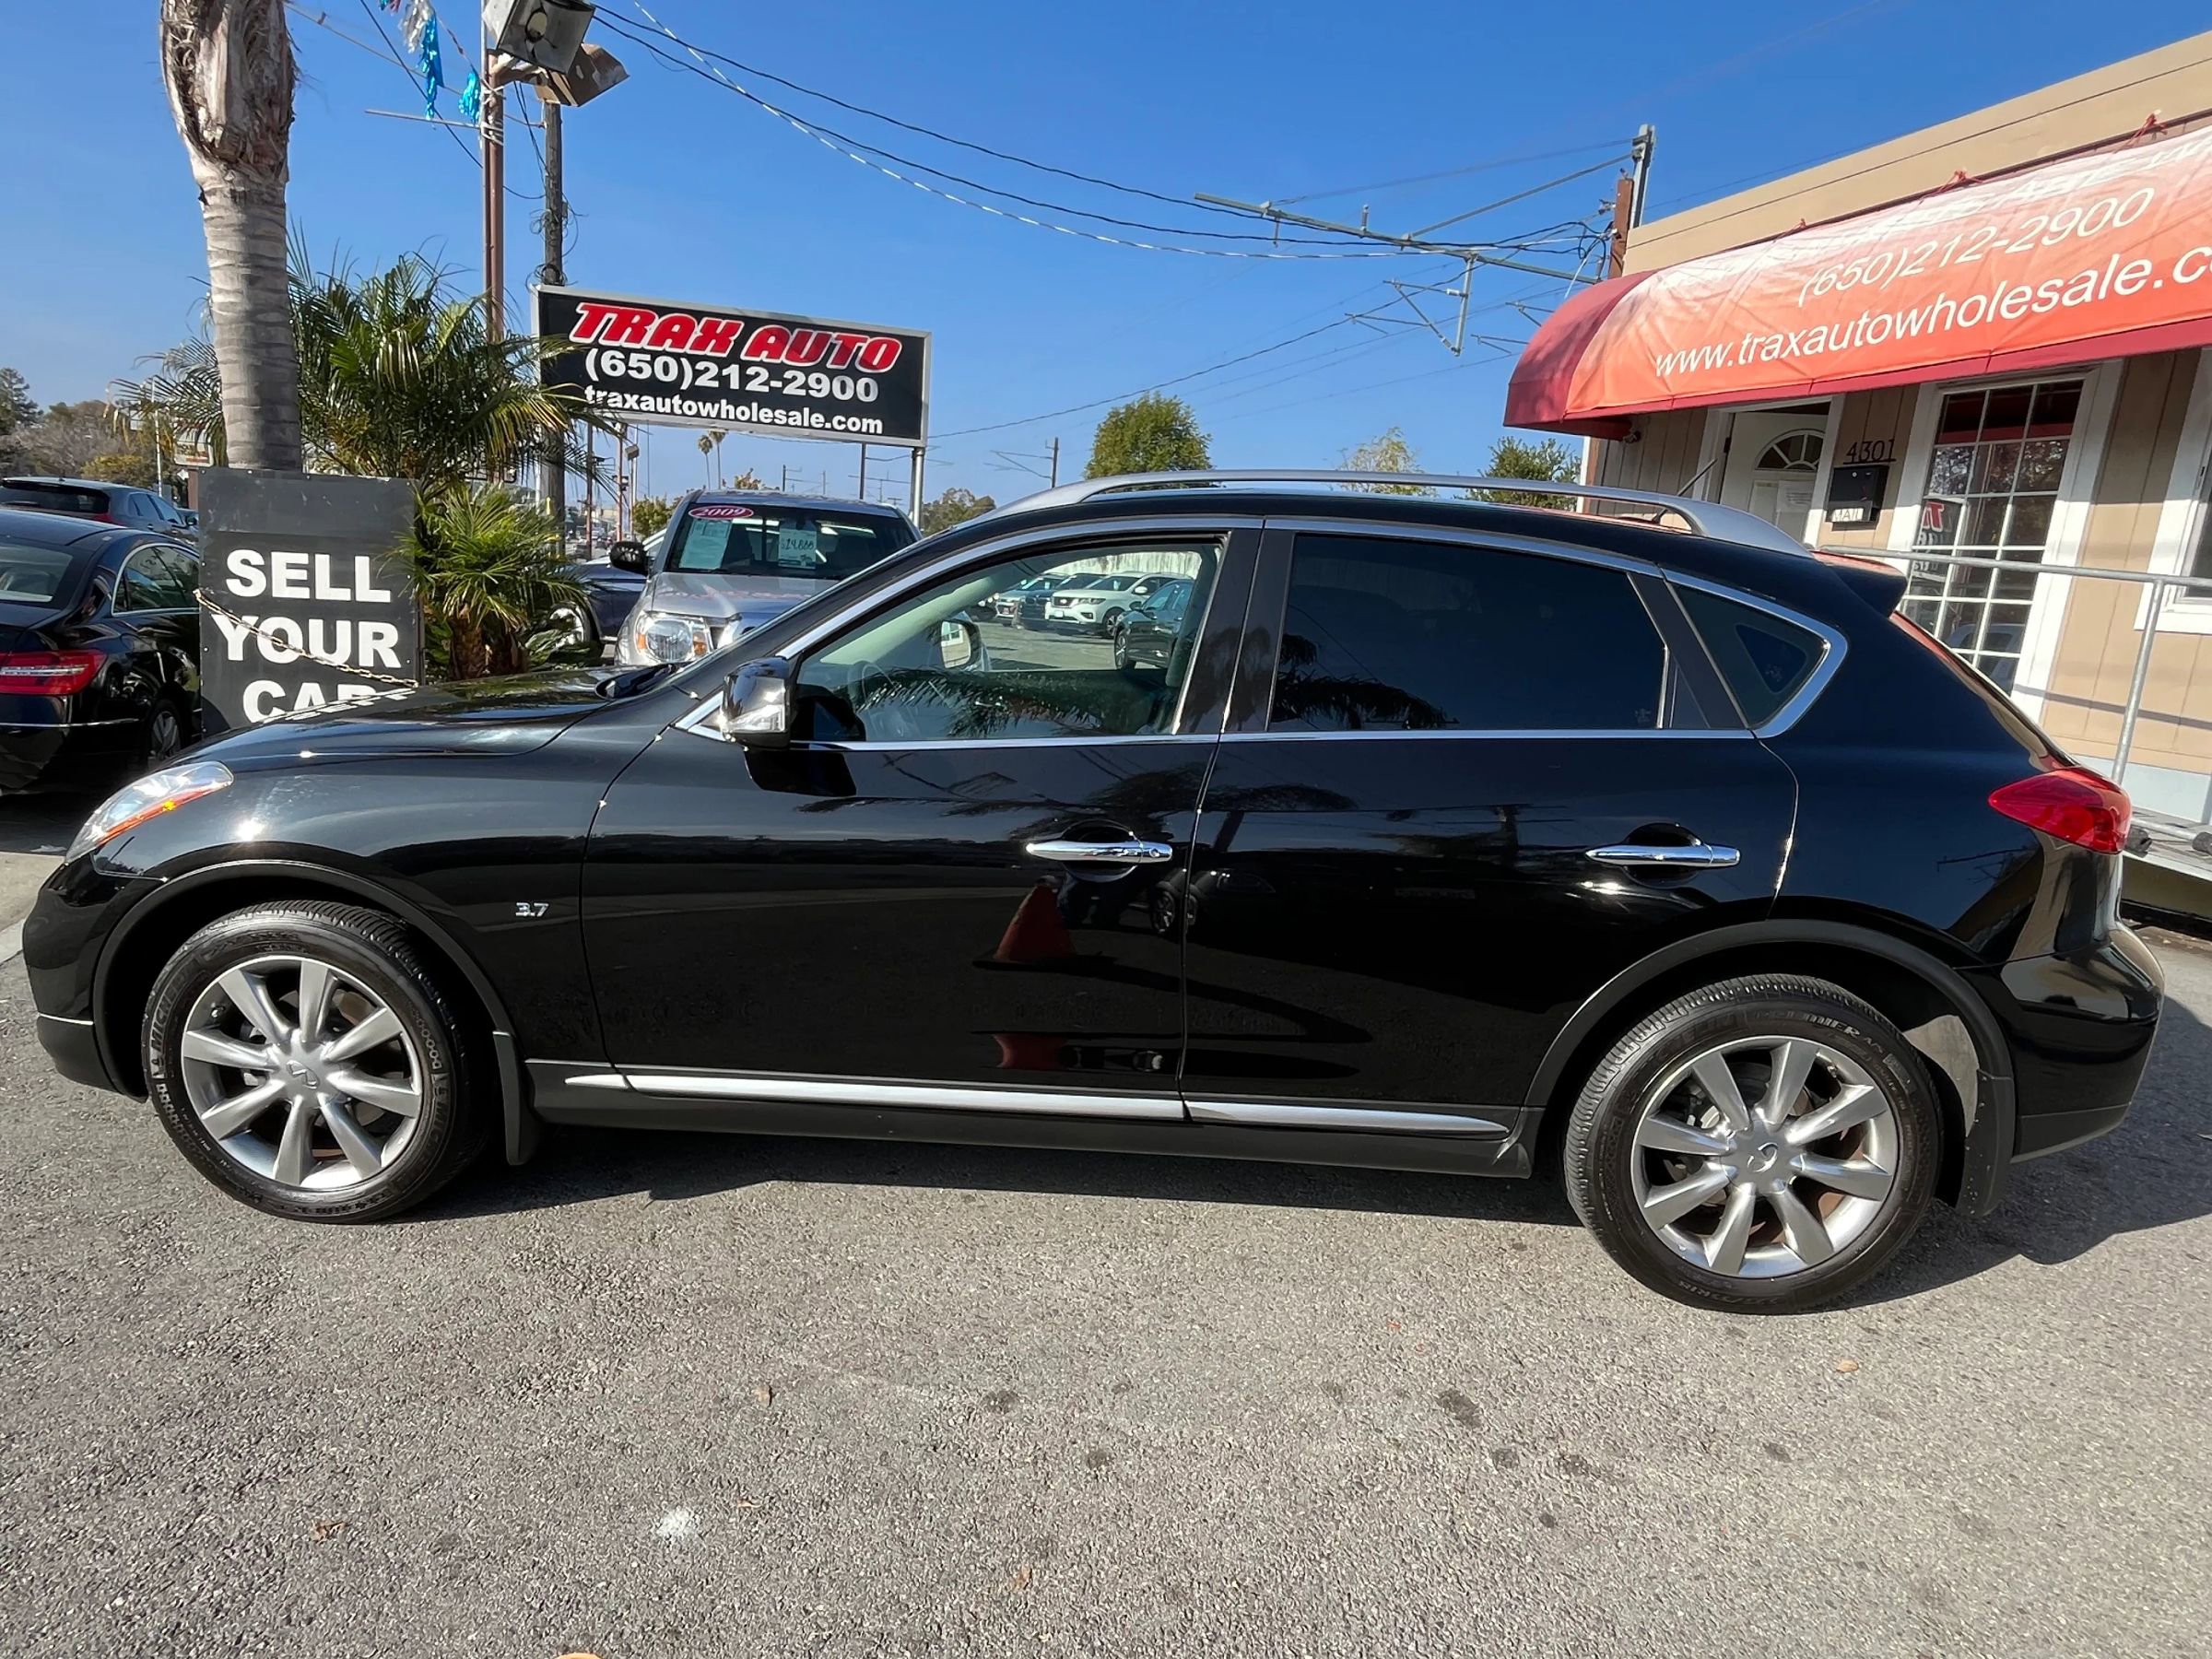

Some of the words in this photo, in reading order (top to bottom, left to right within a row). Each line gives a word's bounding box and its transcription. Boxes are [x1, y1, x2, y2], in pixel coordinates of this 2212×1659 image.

[1799, 187, 2155, 306] (650)212-2900
[570, 302, 744, 356] TRAX
[741, 324, 902, 372] AUTO
[1656, 246, 2212, 377] www.traxautowholesale.c
[585, 348, 879, 402] (650)212-2900
[583, 384, 882, 434] traxautowholesale.com
[1846, 439, 1894, 463] 4301
[697, 508, 746, 517] 2009
[226, 549, 391, 603] SELL
[211, 614, 402, 669] YOUR
